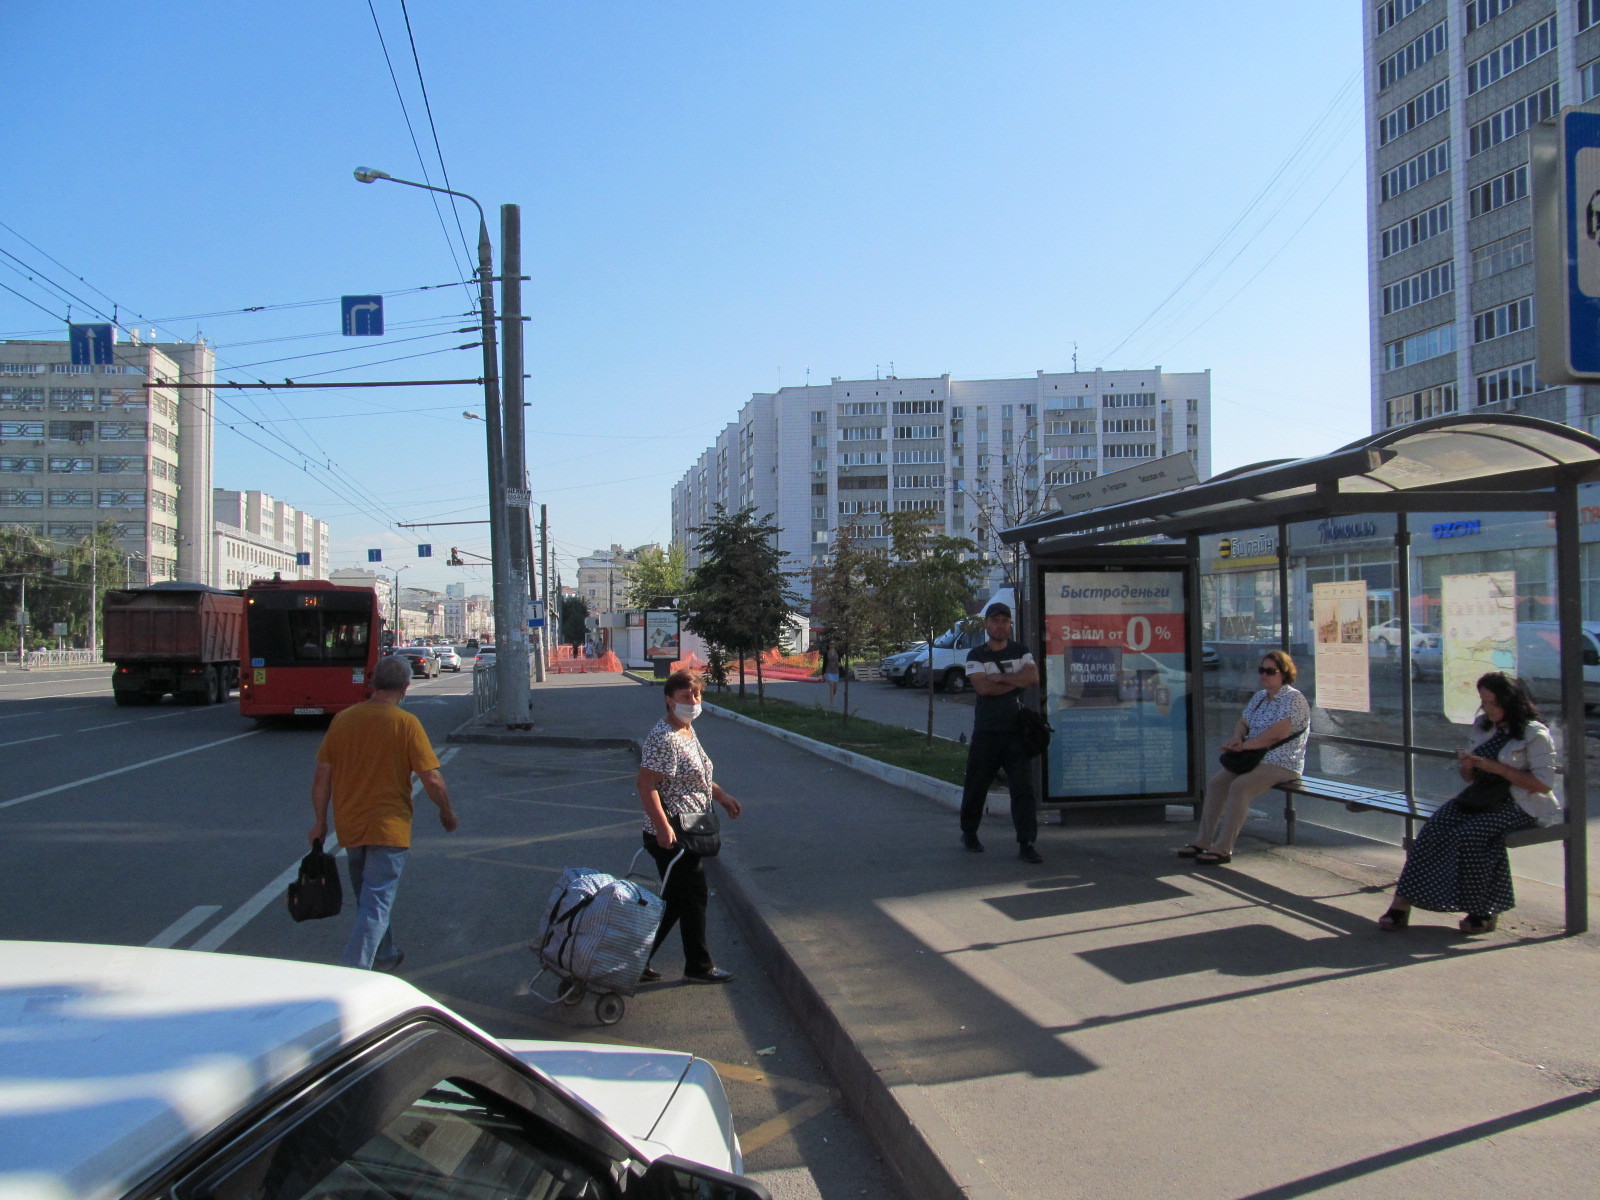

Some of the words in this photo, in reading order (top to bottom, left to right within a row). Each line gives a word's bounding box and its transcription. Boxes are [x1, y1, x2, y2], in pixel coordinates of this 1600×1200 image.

[1432, 519, 1481, 540] OZON
[1231, 533, 1274, 558] билайн
[1060, 584, 1170, 602] Быстроденьги
[1061, 625, 1104, 640] Займ
[1108, 630, 1123, 640] от
[1070, 663, 1116, 673] ПОДАРКИ
[1071, 673, 1078, 682] К
[1080, 673, 1116, 683] ШКОЛЕ
